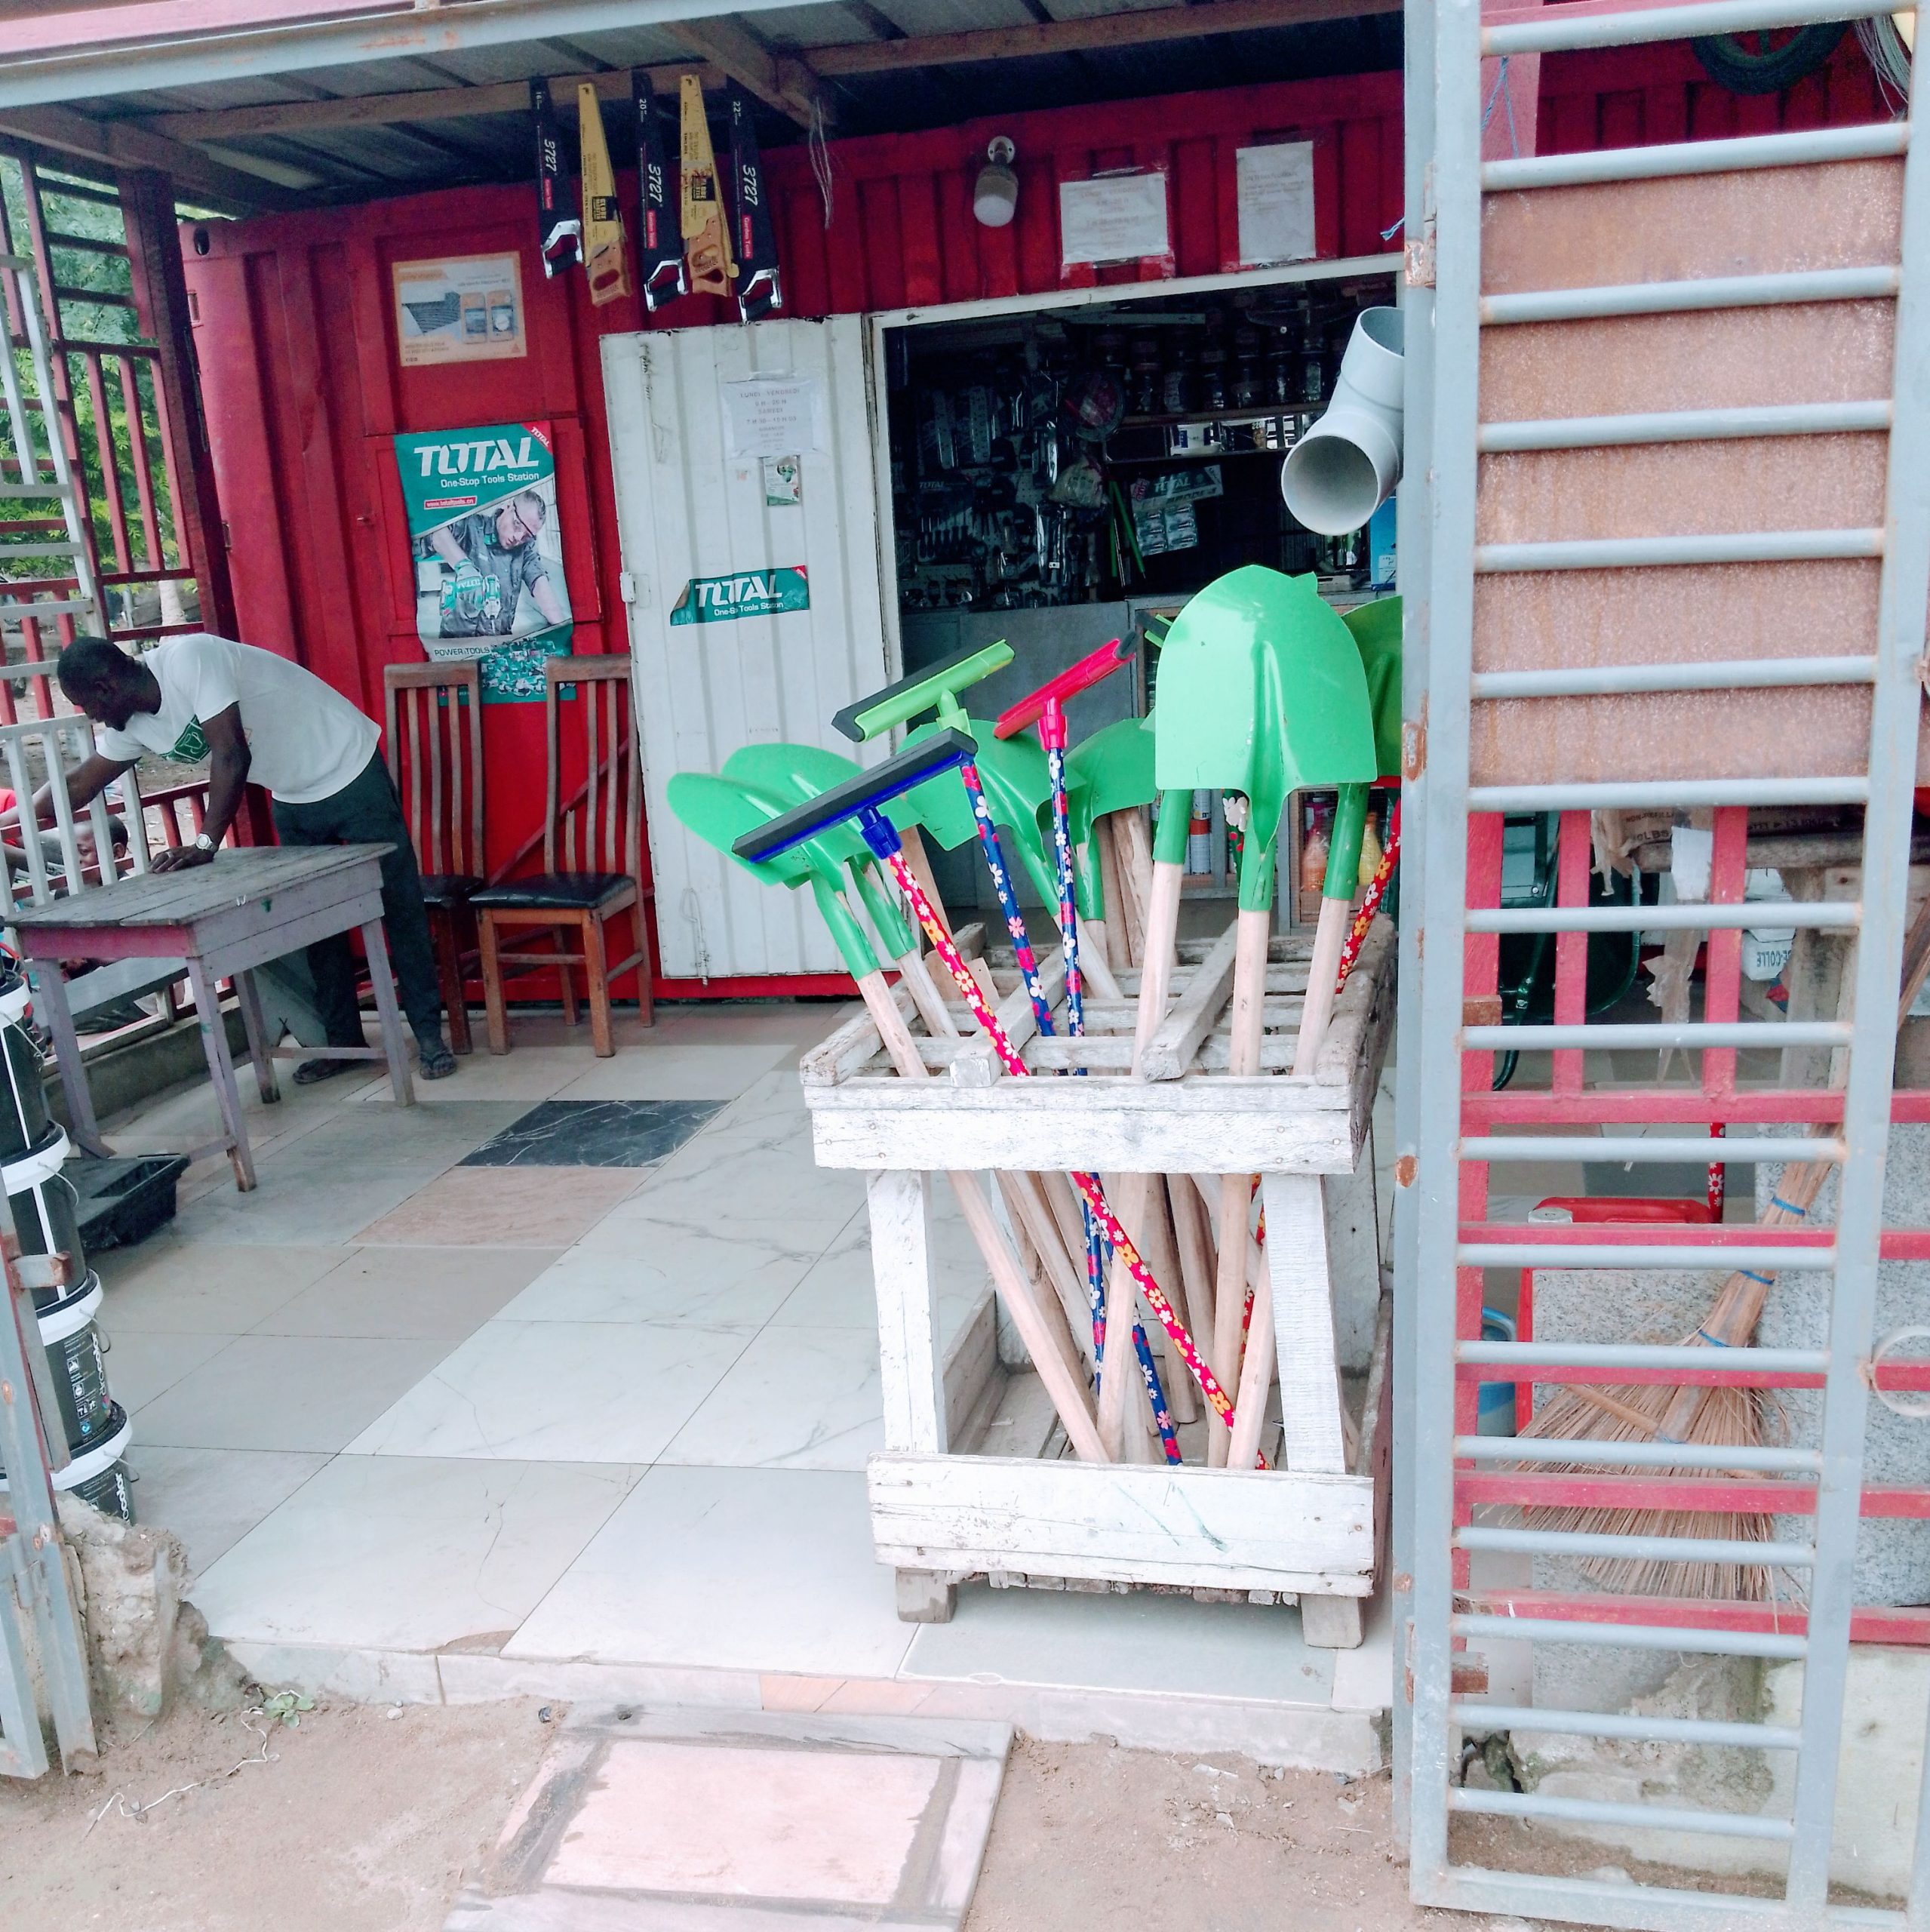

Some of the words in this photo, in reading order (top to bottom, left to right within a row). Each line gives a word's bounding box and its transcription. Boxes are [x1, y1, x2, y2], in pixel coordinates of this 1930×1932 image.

[544, 139, 557, 172] 3727
[648, 164, 662, 203] 3727
[742, 165, 758, 206] 3727
[530, 426, 550, 447] TOTAL
[413, 437, 539, 476] TOTAL
[441, 476, 480, 488] One-Stop
[481, 474, 506, 484] Tools
[507, 472, 539, 481] Station
[695, 574, 782, 608] TOTAL
[739, 603, 759, 613] Tools
[434, 648, 463, 657] POWER
